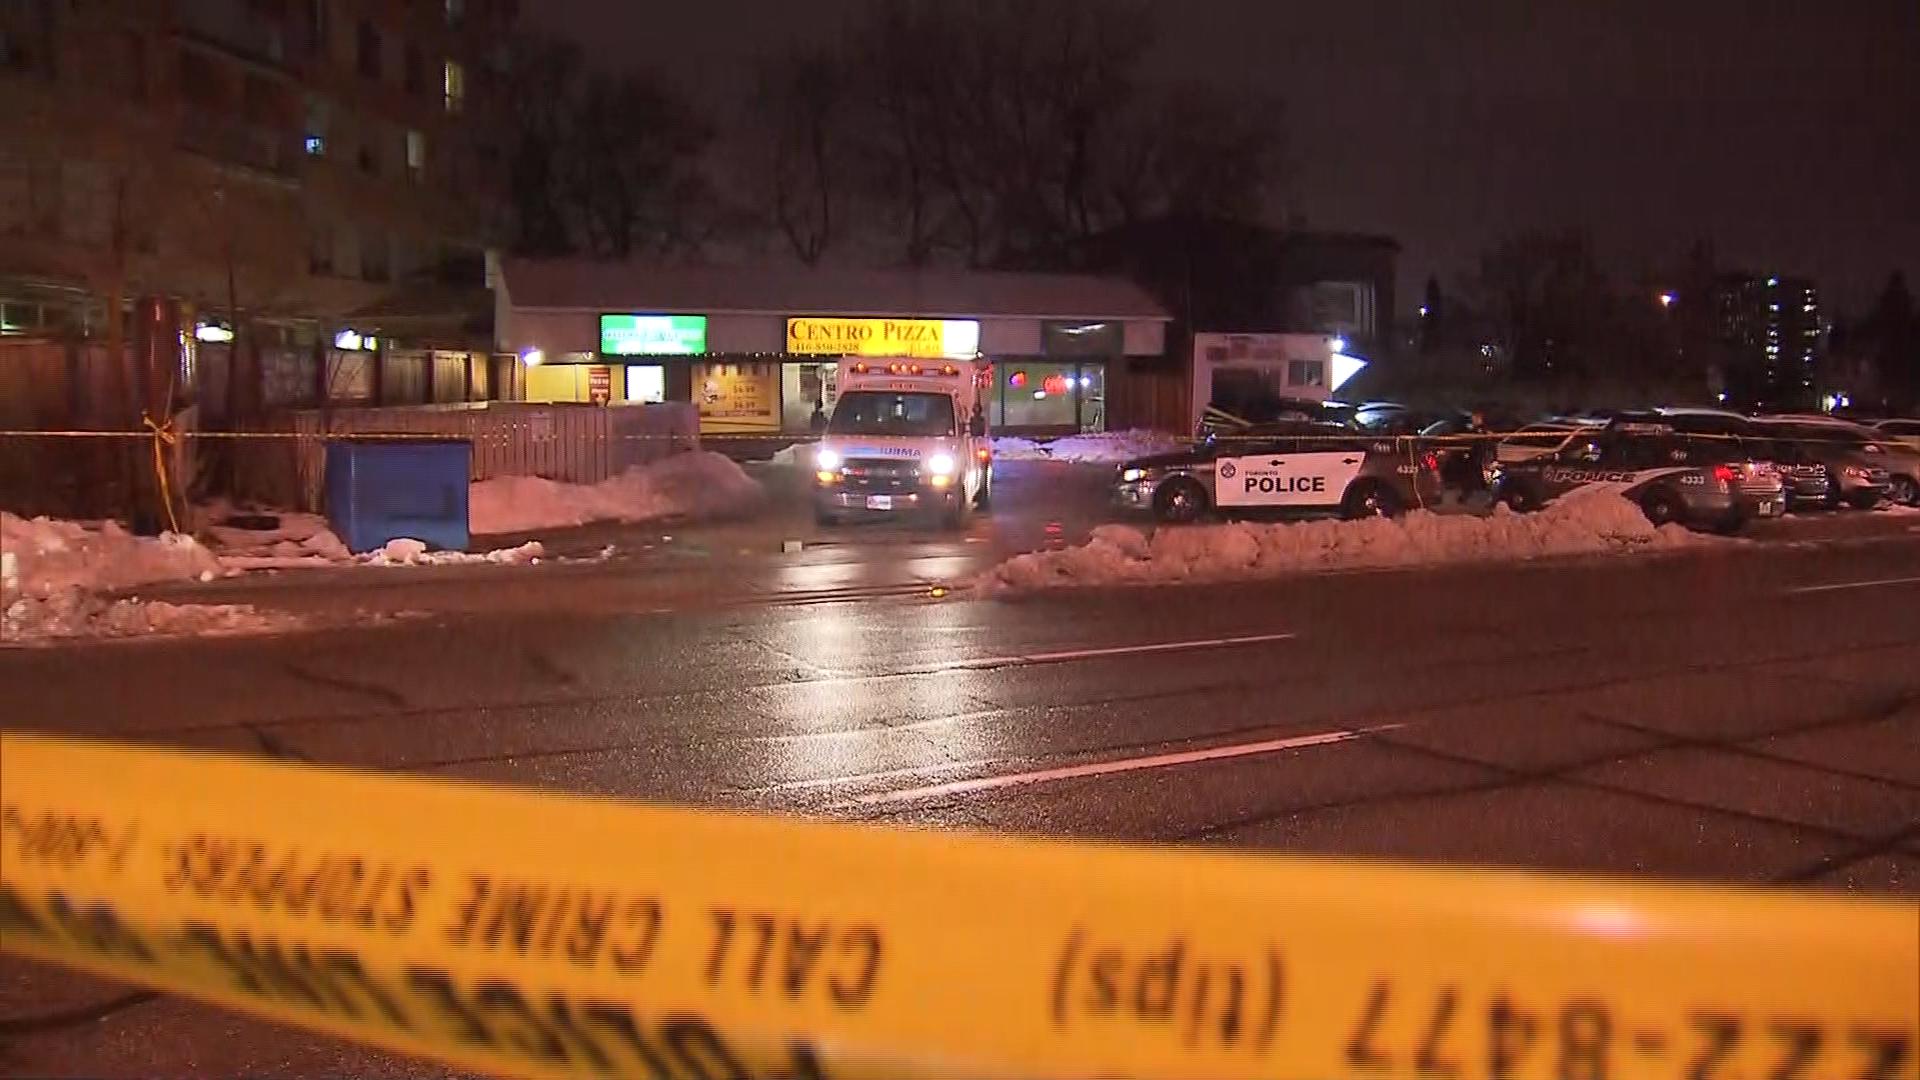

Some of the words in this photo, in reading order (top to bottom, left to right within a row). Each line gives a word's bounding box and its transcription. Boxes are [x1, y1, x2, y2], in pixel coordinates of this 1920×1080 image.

[790, 320, 873, 340] CENTRO
[883, 321, 938, 341] PIZZA
[1244, 476, 1326, 492] POLICE
[1554, 470, 1637, 483] POLICE
[1679, 475, 1705, 485] 4333
[442, 870, 665, 976] CRIME
[700, 906, 884, 1014] CALL
[1046, 924, 1290, 1060] (tips)
